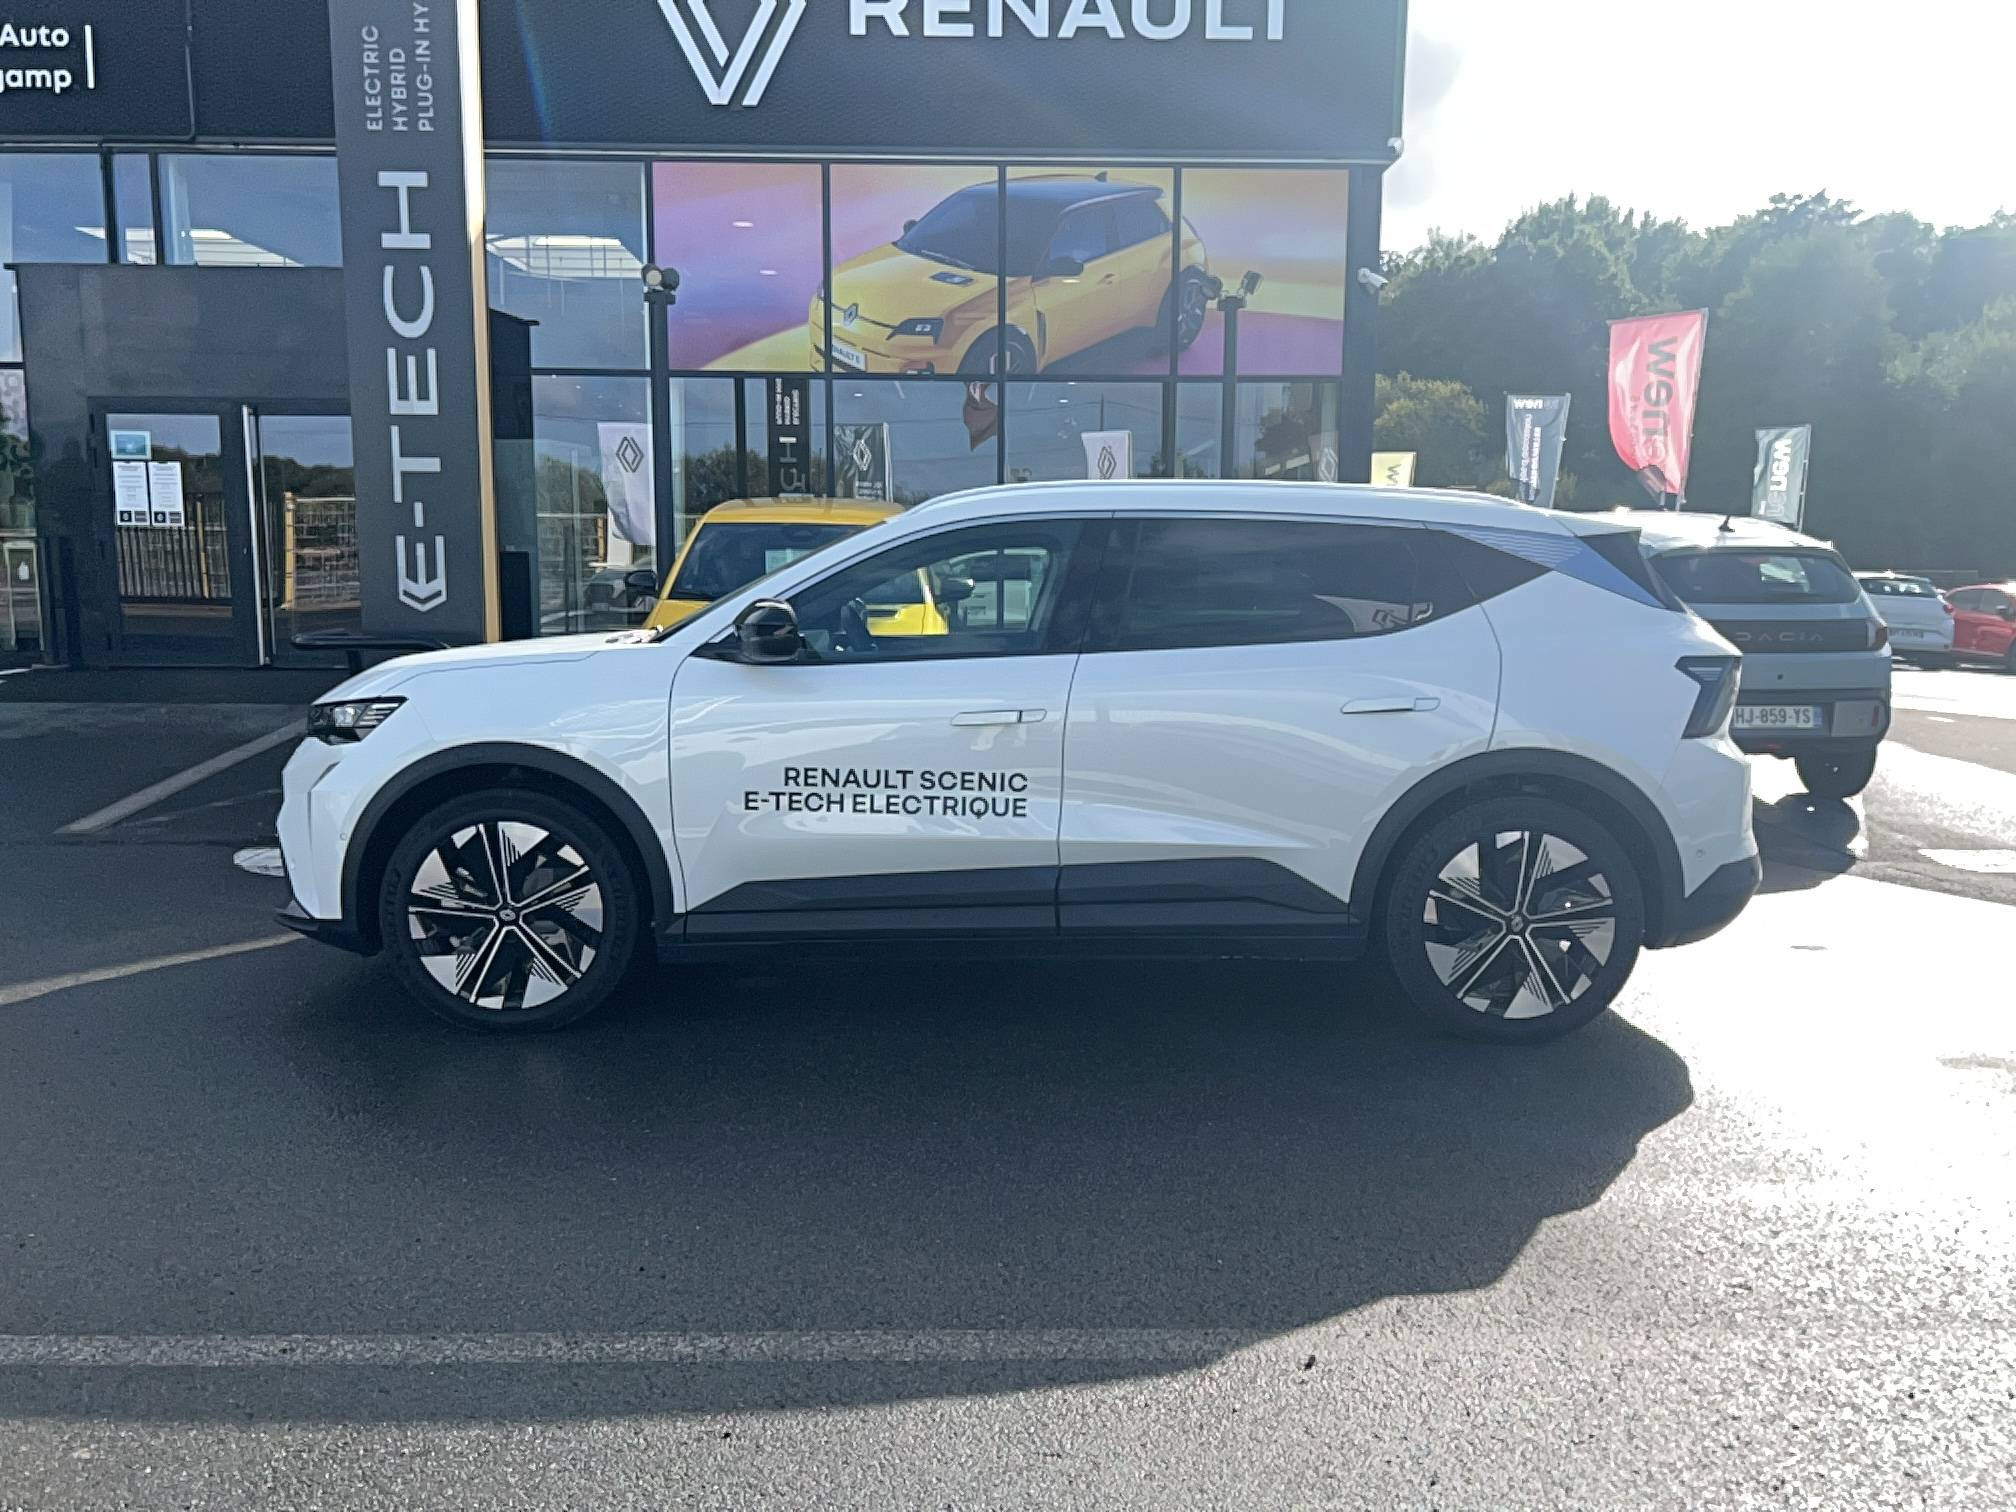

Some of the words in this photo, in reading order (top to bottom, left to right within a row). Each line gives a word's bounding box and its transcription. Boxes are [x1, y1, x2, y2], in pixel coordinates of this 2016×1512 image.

[848, 0, 1284, 40] RENAULT
[0, 23, 70, 48] Auto
[0, 69, 72, 94] amp
[361, 25, 383, 131] ELECTRIC
[388, 48, 409, 131] HYBRID
[413, 40, 435, 131] PLUG-IN
[377, 170, 448, 612] E-TECH
[1735, 631, 1824, 642] DACIA
[1734, 707, 1812, 724] HJ-859-YS
[783, 766, 914, 788] RENAULT
[919, 770, 1029, 793] SCENIC
[743, 791, 845, 813] E-TECH
[852, 794, 1028, 820] ELECTRIQUE
